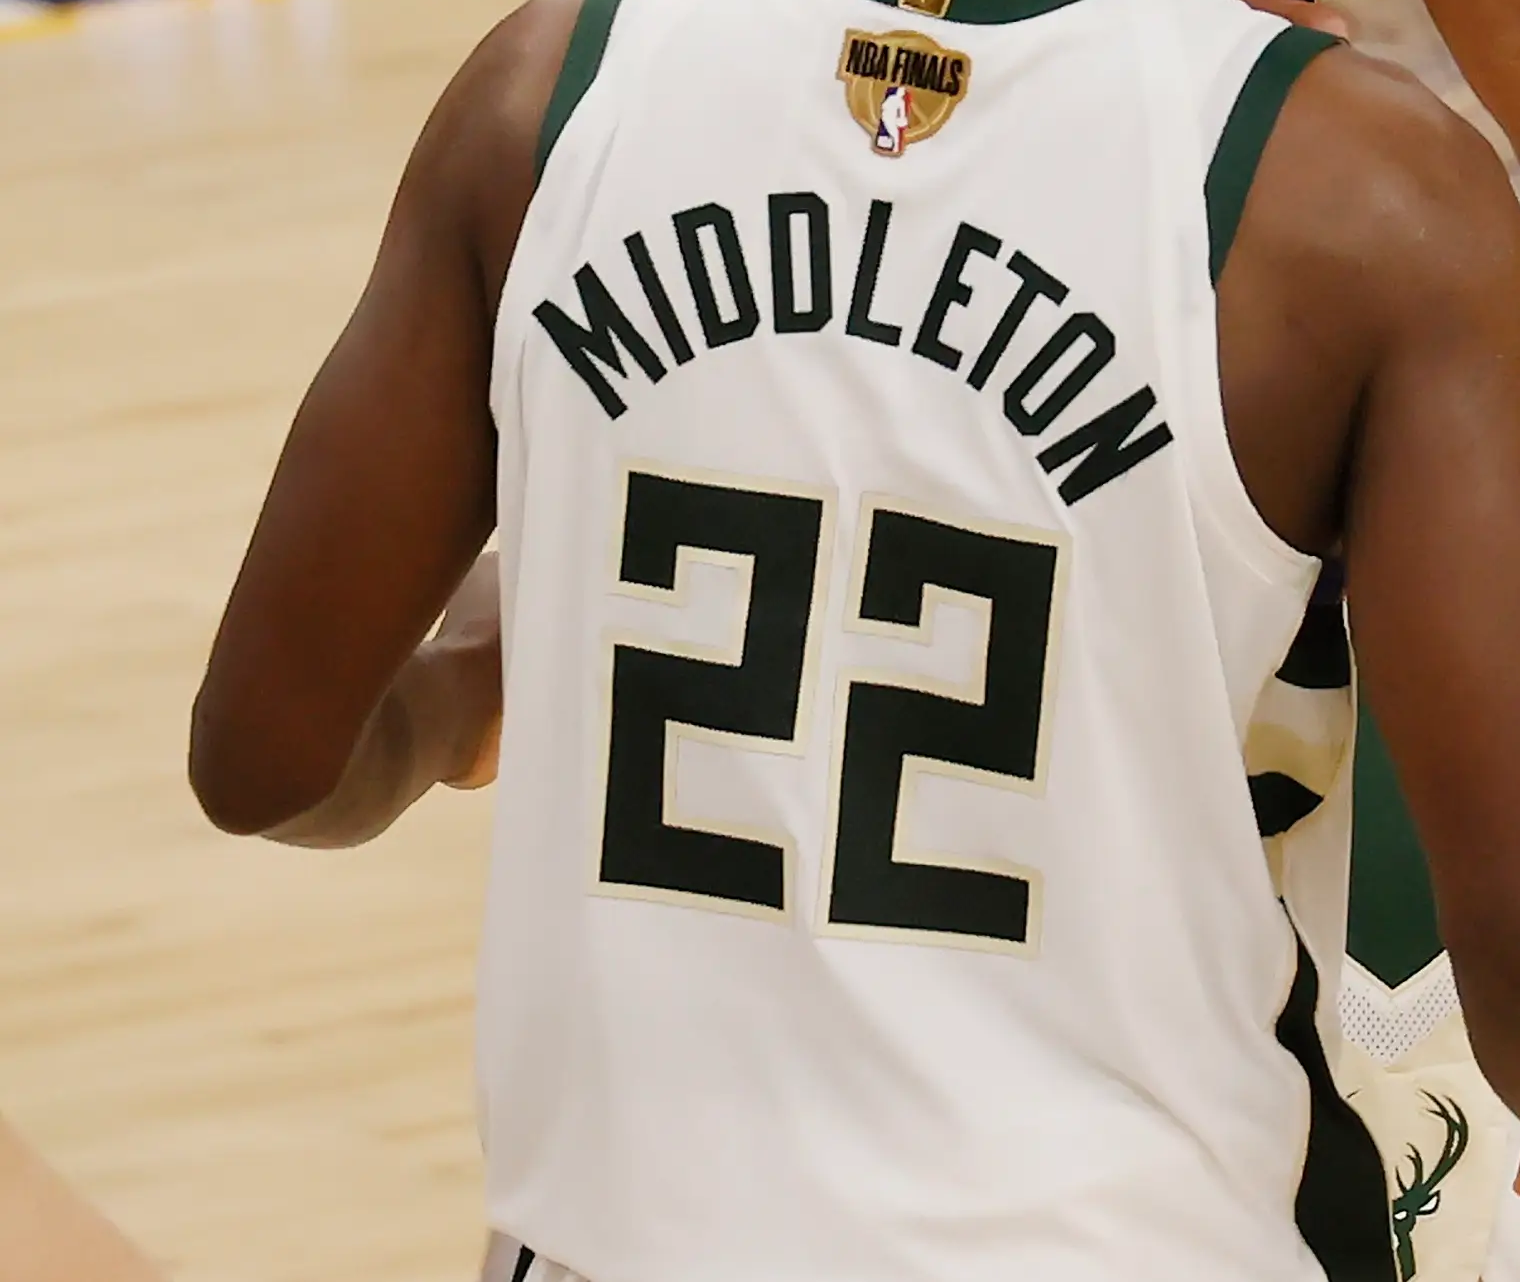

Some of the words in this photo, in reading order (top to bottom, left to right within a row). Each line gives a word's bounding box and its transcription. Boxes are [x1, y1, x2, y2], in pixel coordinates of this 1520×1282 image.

[846, 39, 889, 81] NBA
[891, 47, 964, 97] FINALS
[532, 190, 1175, 507] MIDDLETON
[590, 460, 1070, 956] 22
